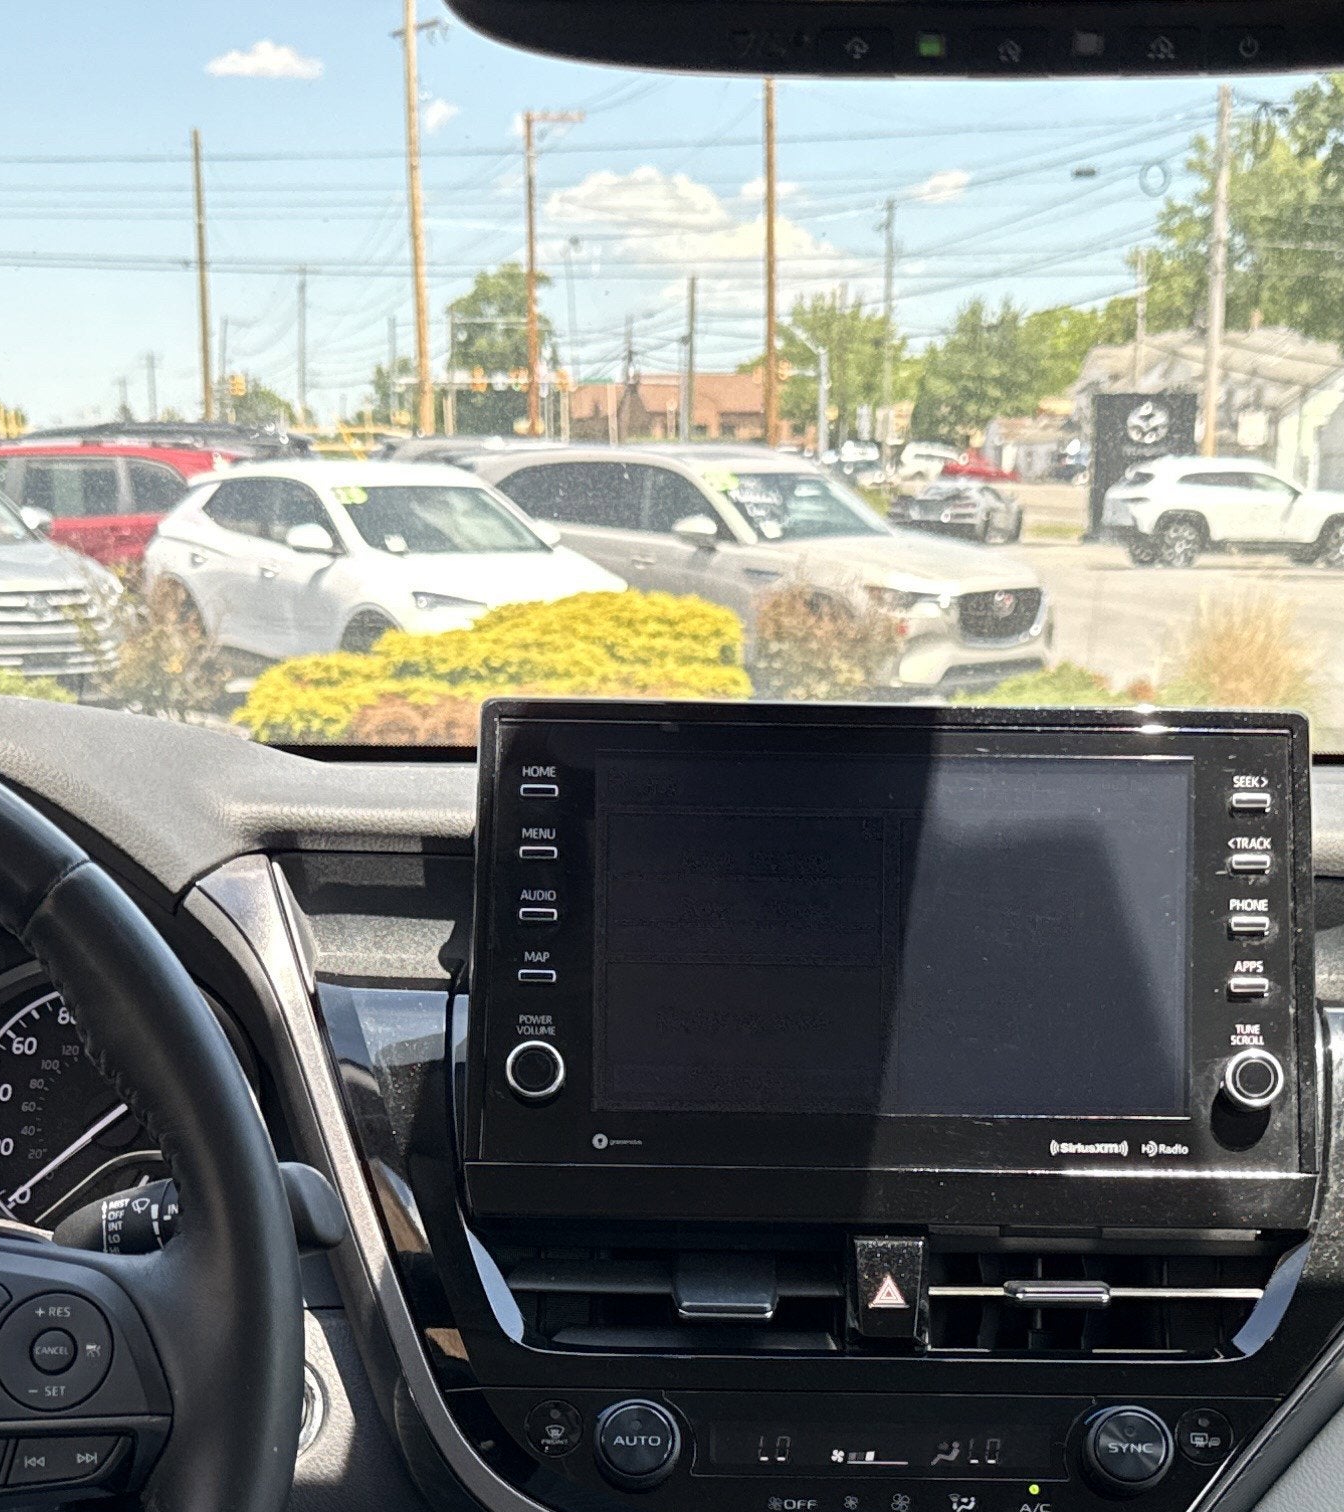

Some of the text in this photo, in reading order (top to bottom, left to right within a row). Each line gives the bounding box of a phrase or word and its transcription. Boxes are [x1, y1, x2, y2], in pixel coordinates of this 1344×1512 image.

[522, 766, 556, 777] HOME
[522, 828, 556, 840] MENU
[520, 890, 556, 901] AUDIO
[1229, 899, 1268, 911] PHONE
[524, 952, 550, 962] MAP
[1234, 960, 1264, 973] APPS
[519, 1014, 553, 1024] POWER
[516, 1026, 556, 1036] VOLUME
[1235, 1024, 1260, 1034] TUNE
[12, 1037, 37, 1055] 60
[1231, 1035, 1264, 1046] SCROLL
[62, 1045, 80, 1056] 120
[41, 1060, 59, 1071] 100
[29, 1079, 44, 1089] 80
[21, 1102, 36, 1112] 60
[21, 1126, 35, 1136] 40
[28, 1149, 42, 1159] 20
[1159, 1144, 1189, 1155] Radio
[108, 1210, 125, 1220] OFF
[108, 1221, 123, 1231] INT
[108, 1234, 120, 1244] LO
[48, 1306, 71, 1318] RES
[35, 1347, 69, 1355] CANCEL
[44, 1386, 65, 1396] SET
[613, 1435, 661, 1446] AUTO
[1108, 1441, 1154, 1454] SYNC
[783, 1499, 818, 1510] OFF
